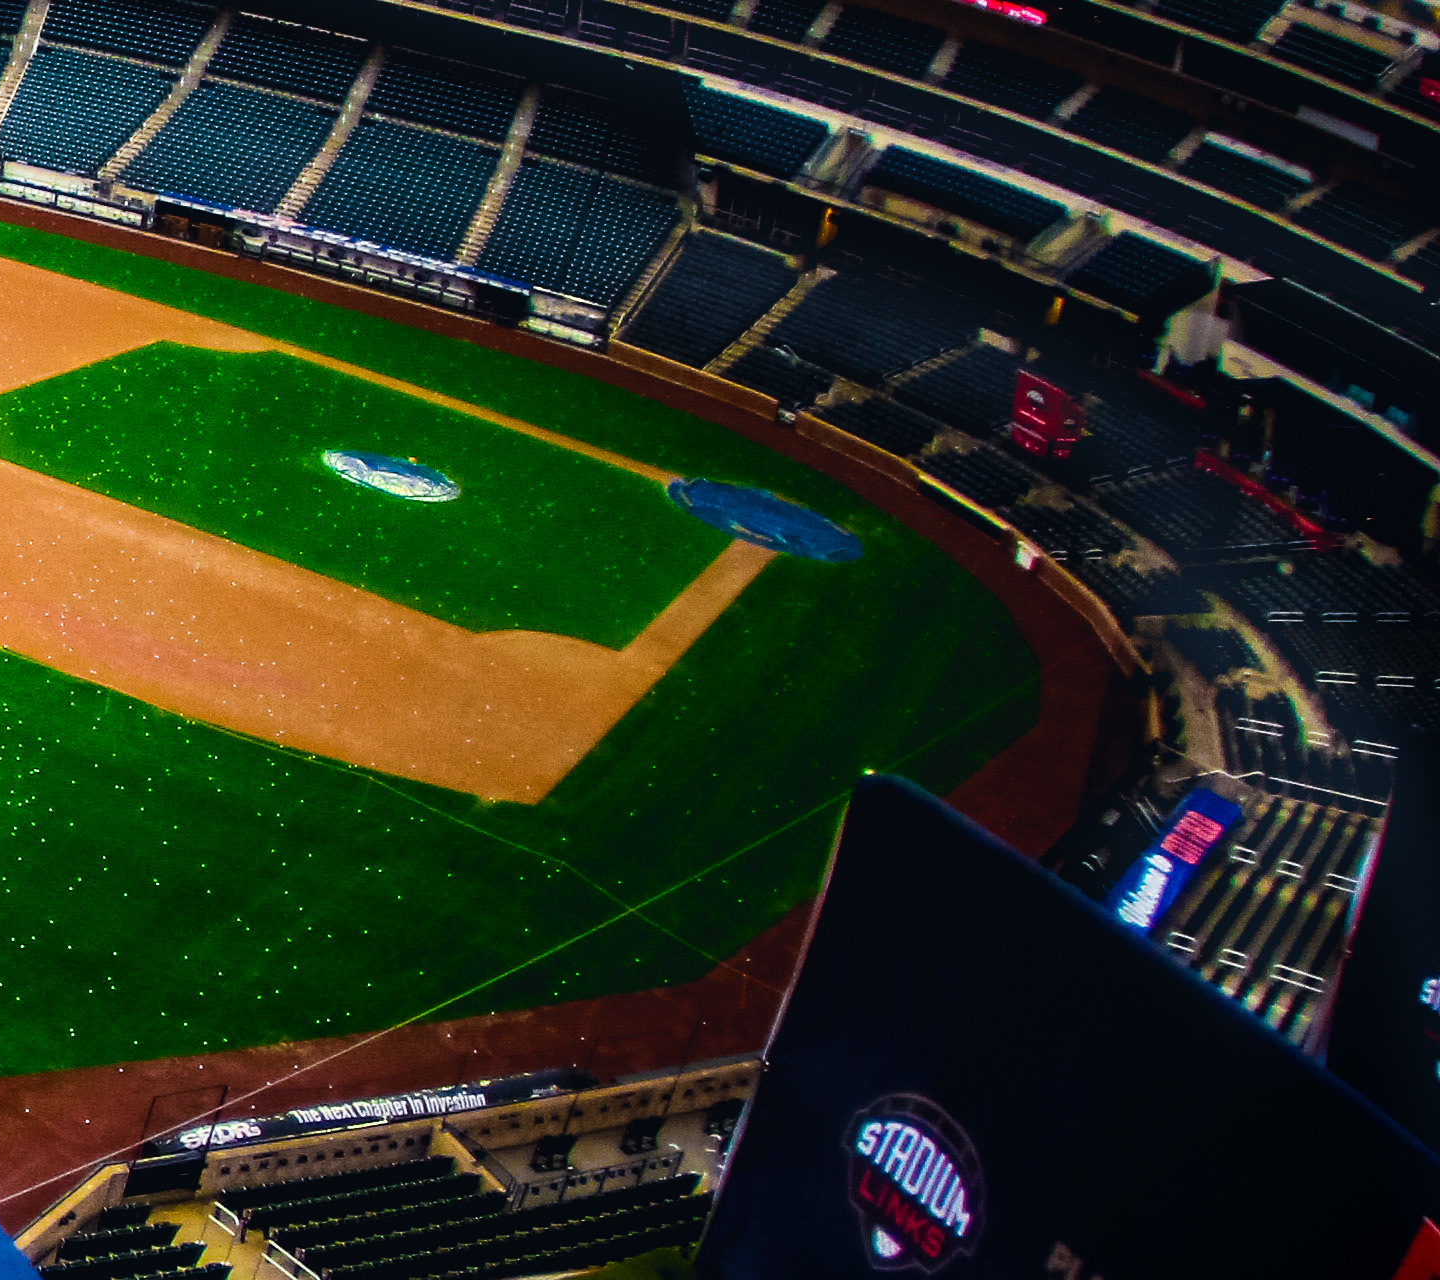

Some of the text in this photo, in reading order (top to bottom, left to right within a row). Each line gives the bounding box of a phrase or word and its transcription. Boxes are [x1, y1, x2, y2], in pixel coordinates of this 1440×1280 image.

[291, 1108, 321, 1125] The
[320, 1104, 357, 1124] Next
[356, 1096, 409, 1120] Chapter
[408, 1097, 424, 1115] In
[855, 1120, 972, 1237] STADIUM
[858, 1167, 945, 1259] LINKS
